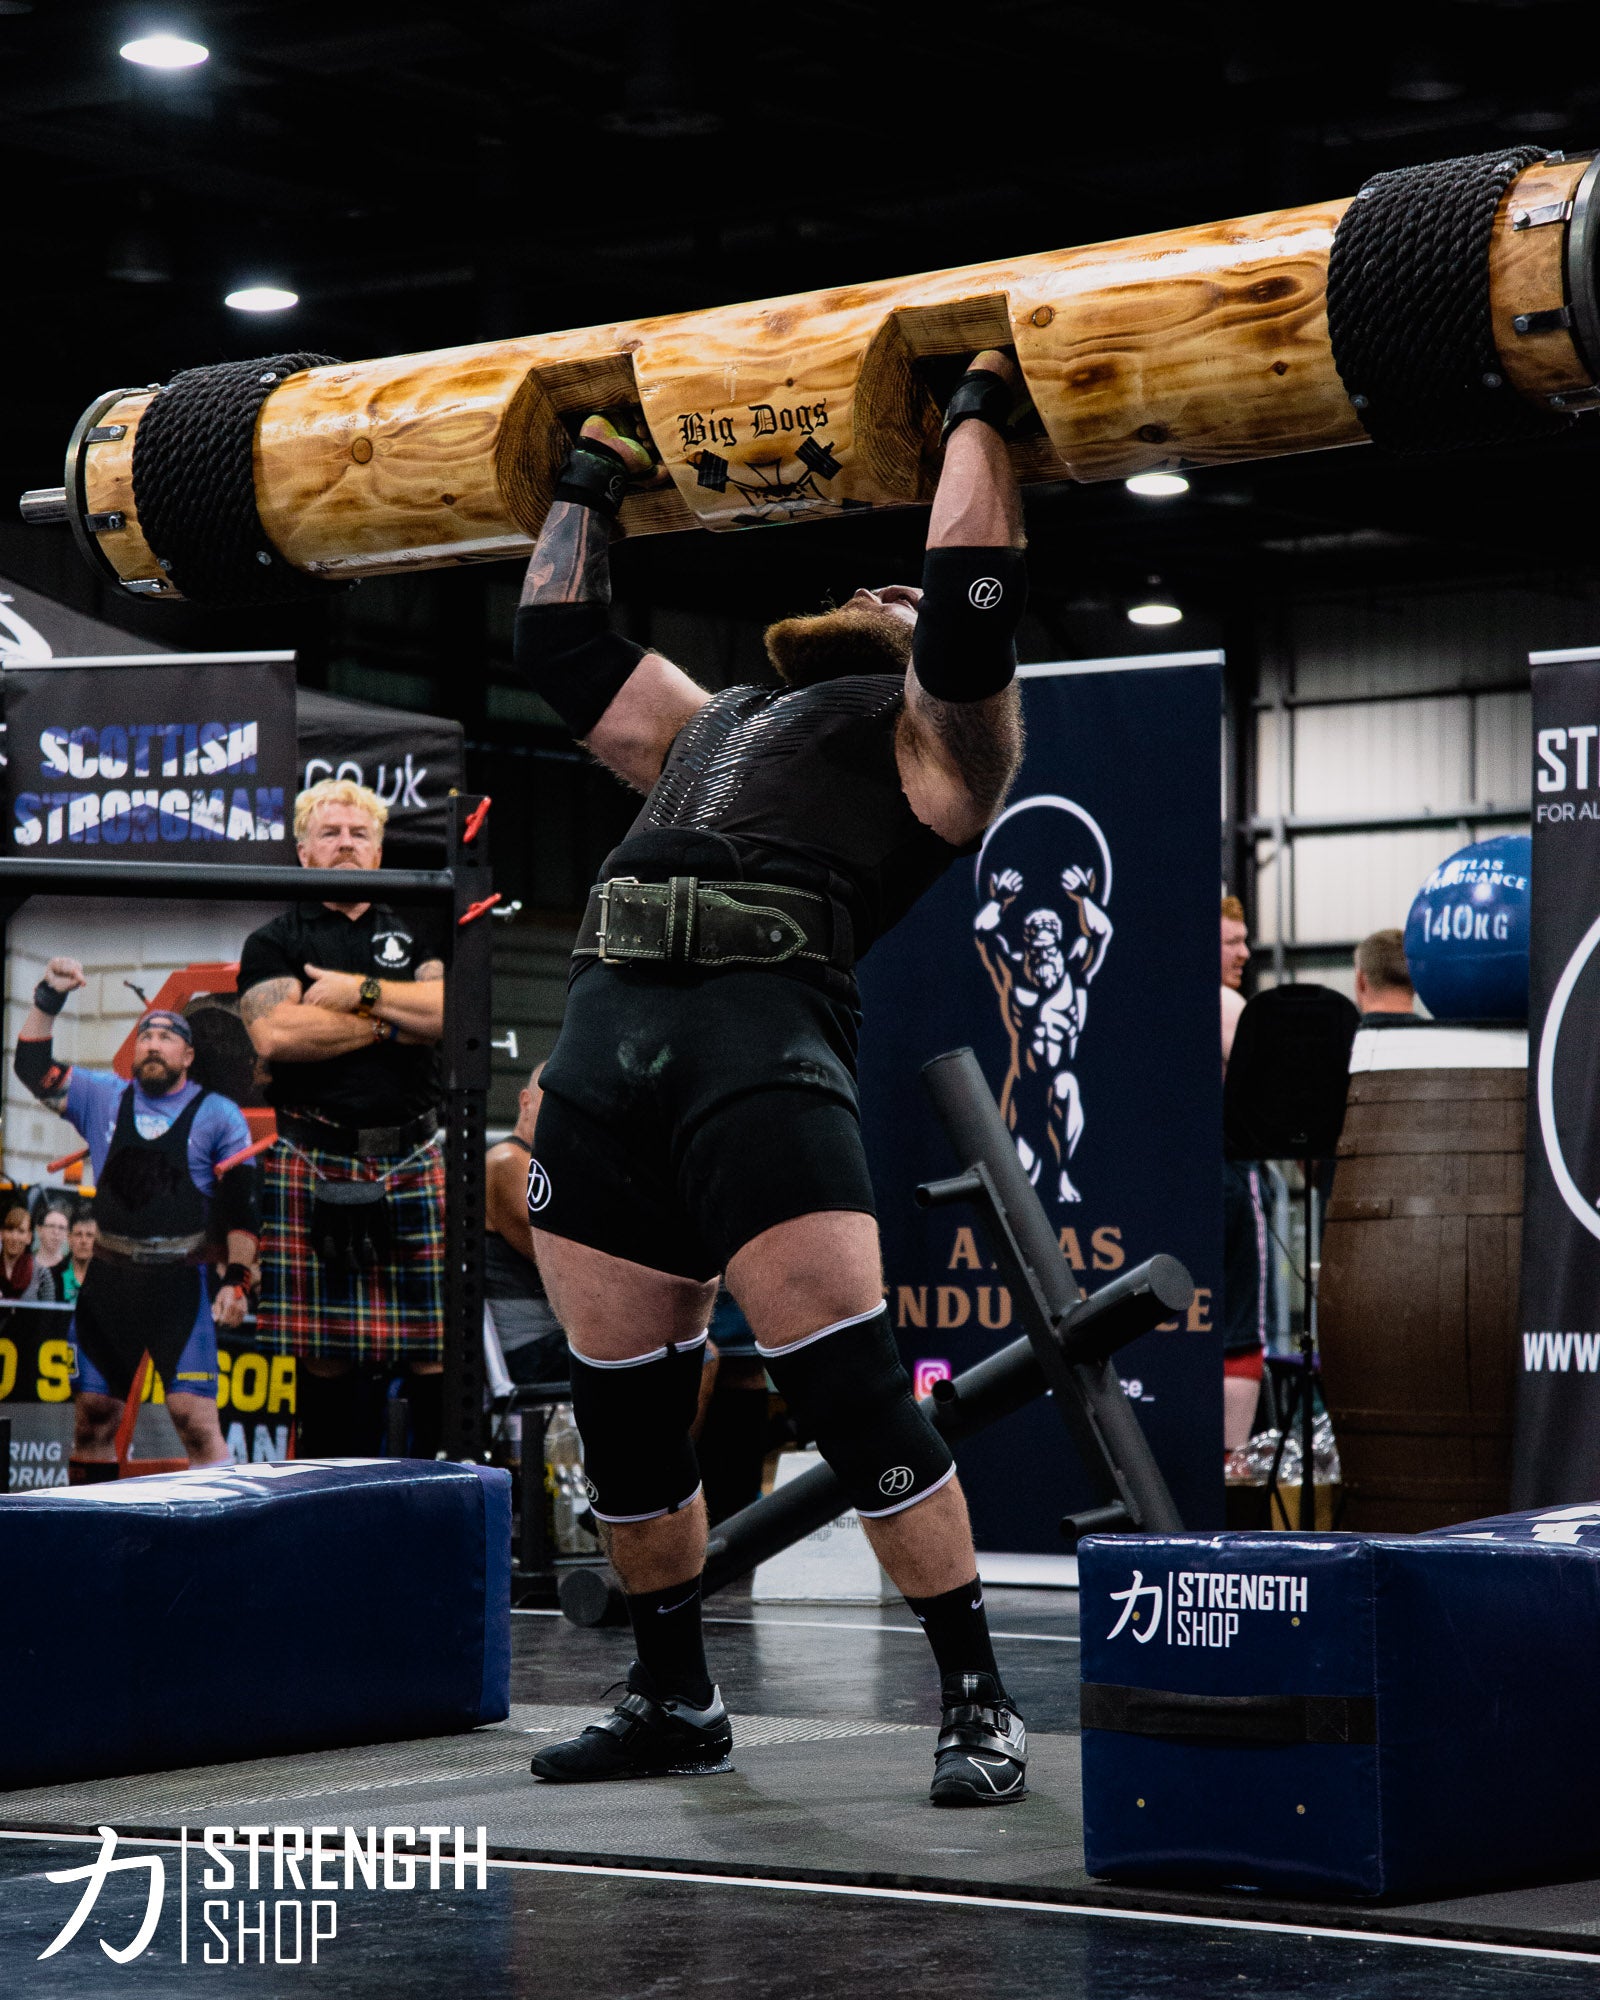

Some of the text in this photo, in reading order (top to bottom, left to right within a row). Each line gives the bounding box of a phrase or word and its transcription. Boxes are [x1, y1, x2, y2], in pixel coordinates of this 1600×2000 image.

[677, 398, 829, 451] Big Dogs
[40, 720, 258, 779] SCOTTISH
[1538, 725, 1600, 793] ST
[14, 786, 284, 845] STRONGMAN
[1537, 802, 1575, 823] FOR
[9, 1442, 62, 1461] RING
[1177, 1572, 1308, 1612] STRENGTH
[1177, 1610, 1239, 1648] SHOP
